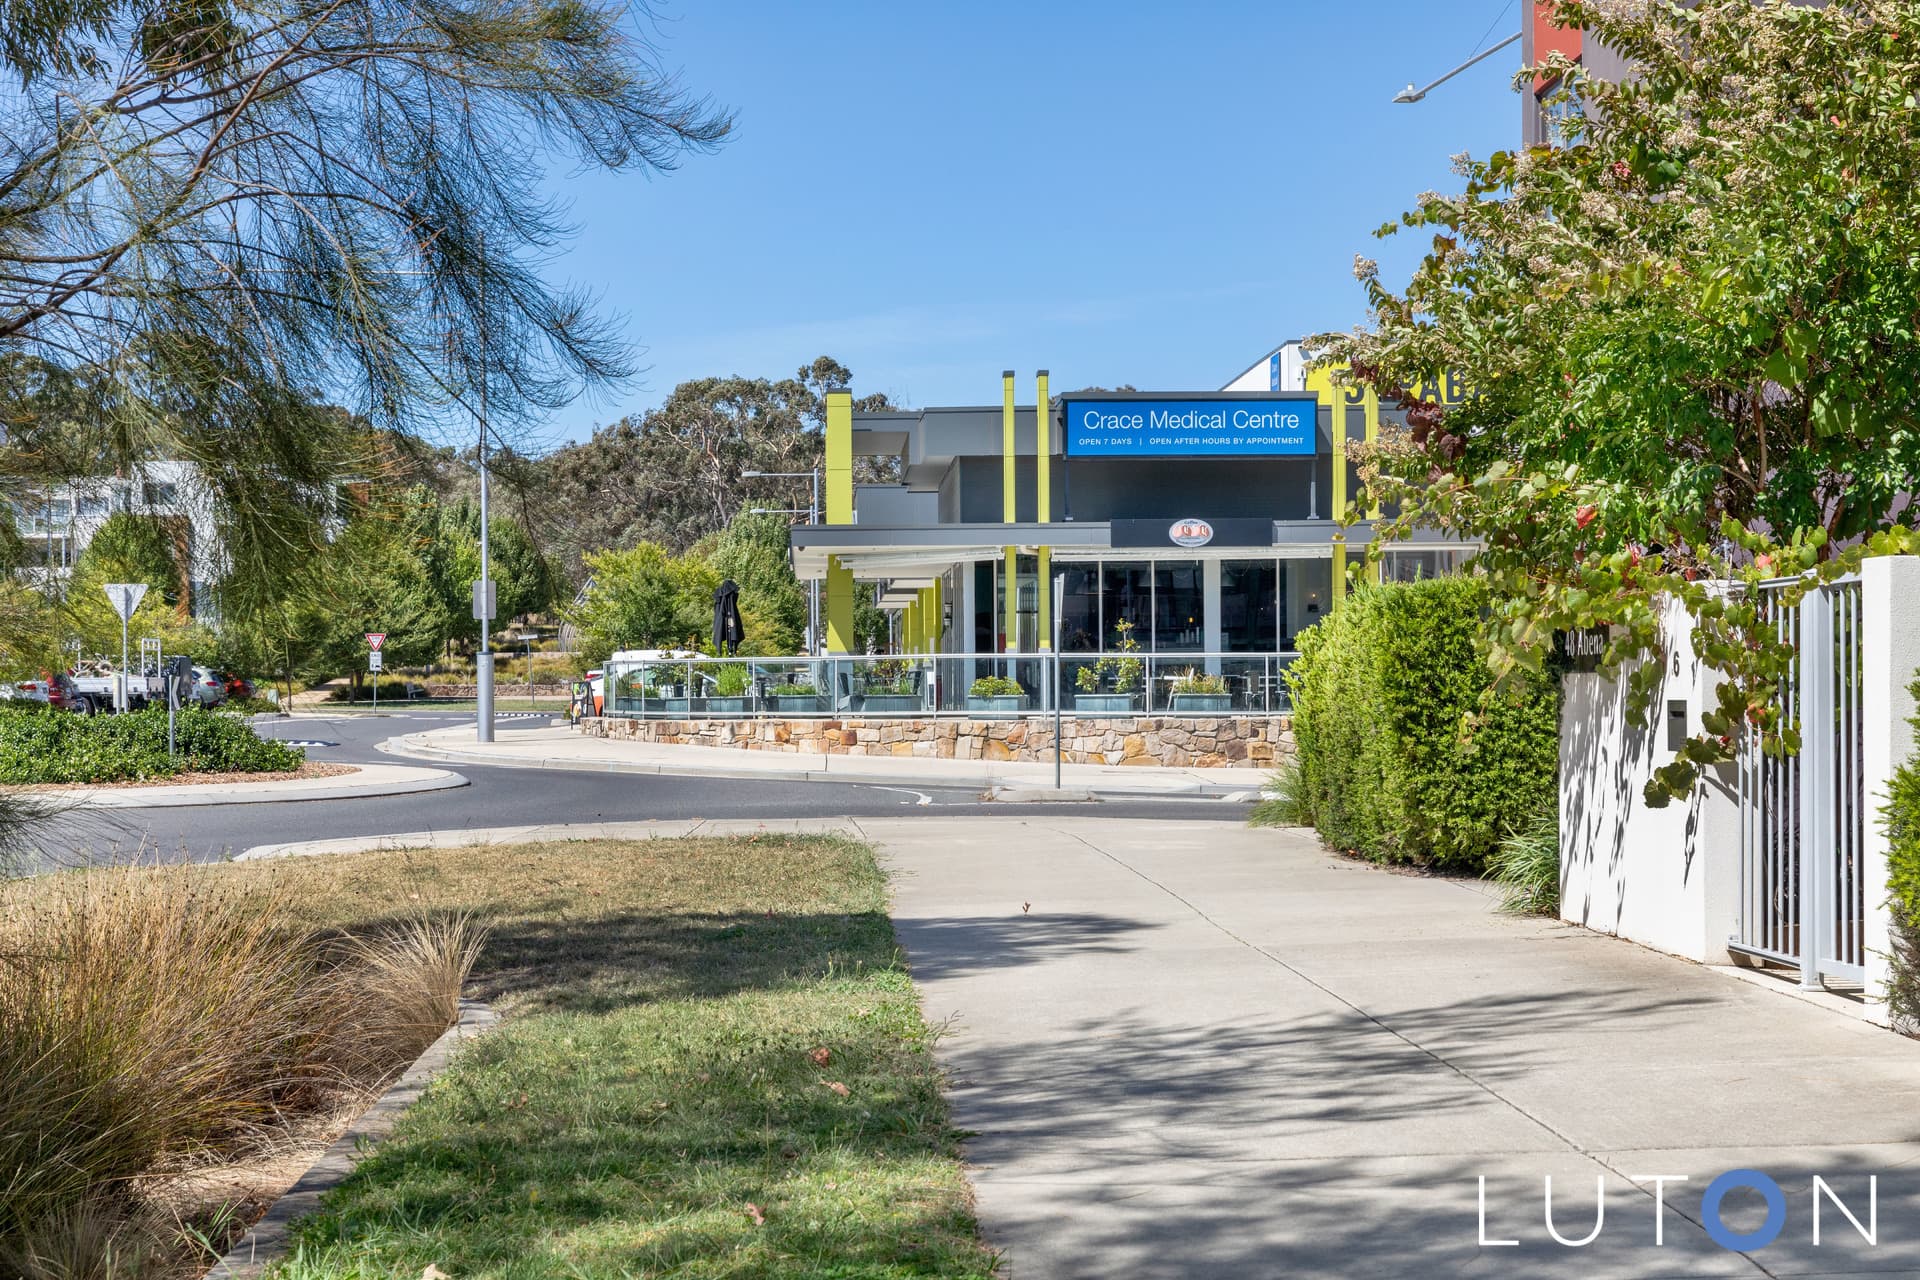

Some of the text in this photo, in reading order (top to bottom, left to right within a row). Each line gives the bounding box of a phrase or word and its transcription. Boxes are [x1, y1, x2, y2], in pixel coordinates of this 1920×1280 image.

[1083, 410, 1299, 429] Crace Medical Centre
[1149, 437, 1304, 445] OPEN AFTER HOURS BY APPOINTMENT
[1564, 627, 1603, 657] 48 Abena
[1673, 651, 1680, 677] 6
